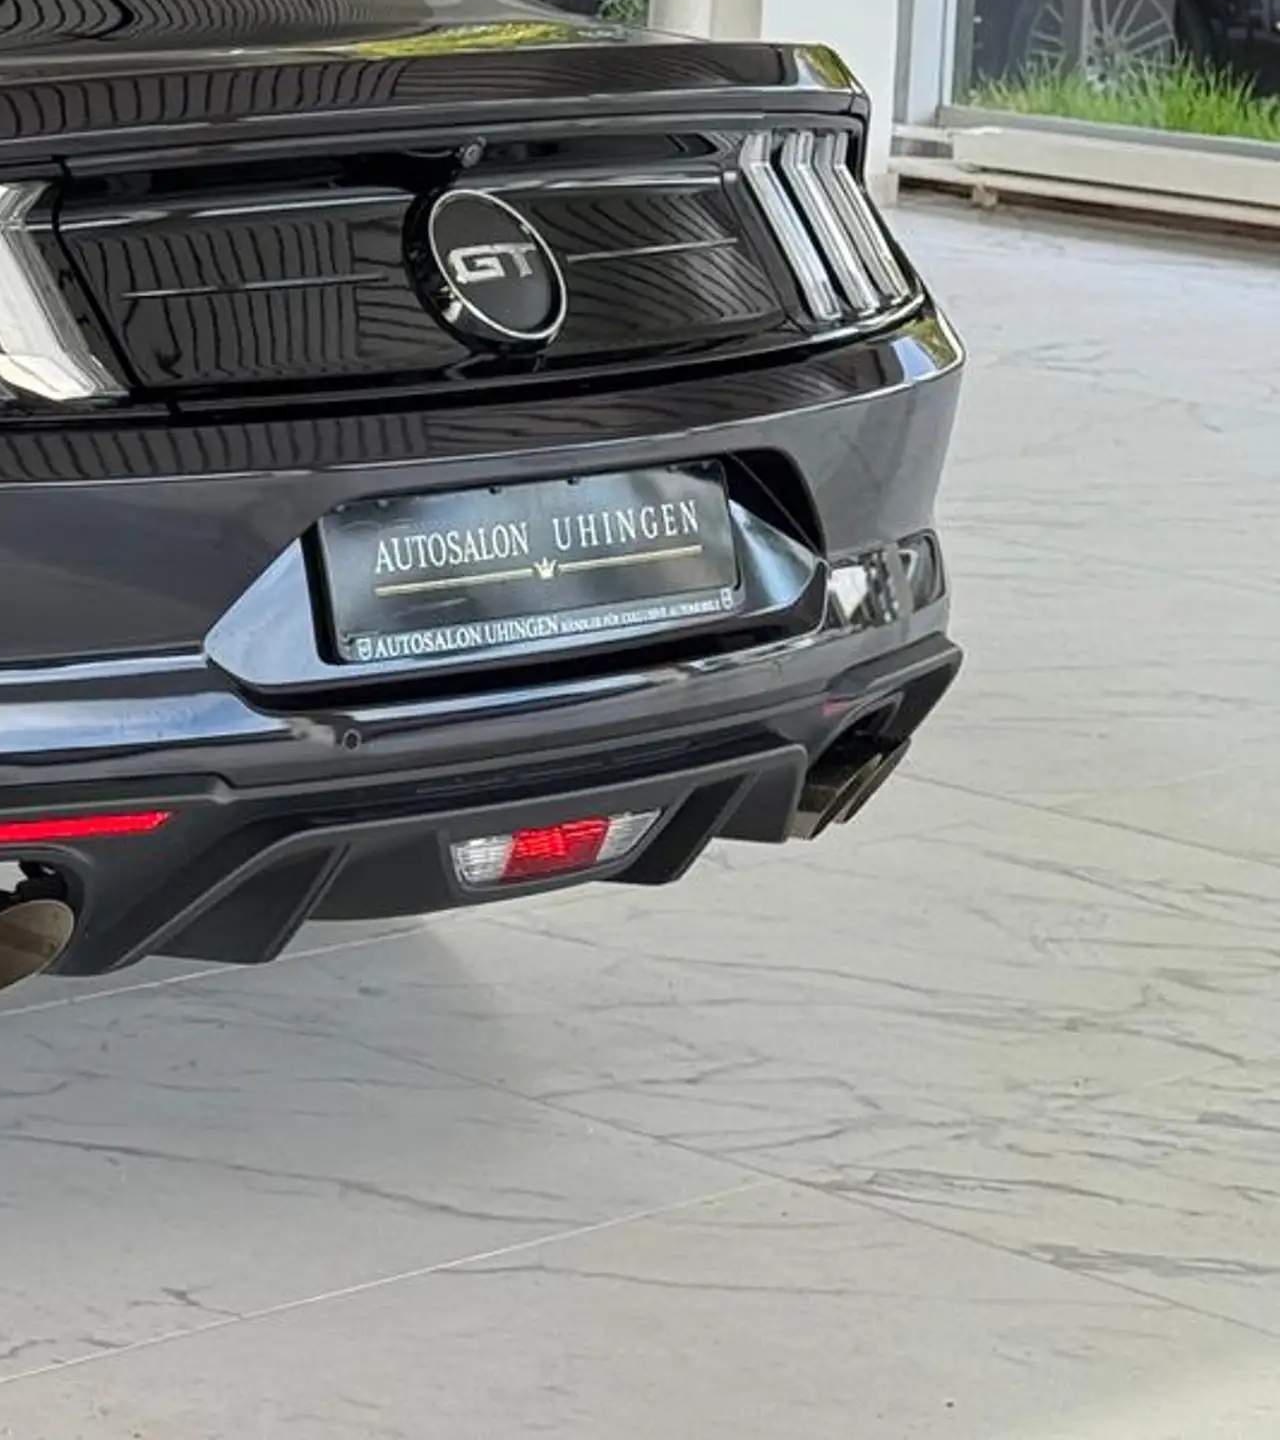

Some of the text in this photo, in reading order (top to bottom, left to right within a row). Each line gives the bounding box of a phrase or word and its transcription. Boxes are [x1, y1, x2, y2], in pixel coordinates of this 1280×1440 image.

[448, 244, 535, 284] GT
[375, 499, 698, 573] AUTOSALON UHINGEN
[375, 627, 482, 659] AUTOSALON
[484, 614, 559, 644] UHINGEN
